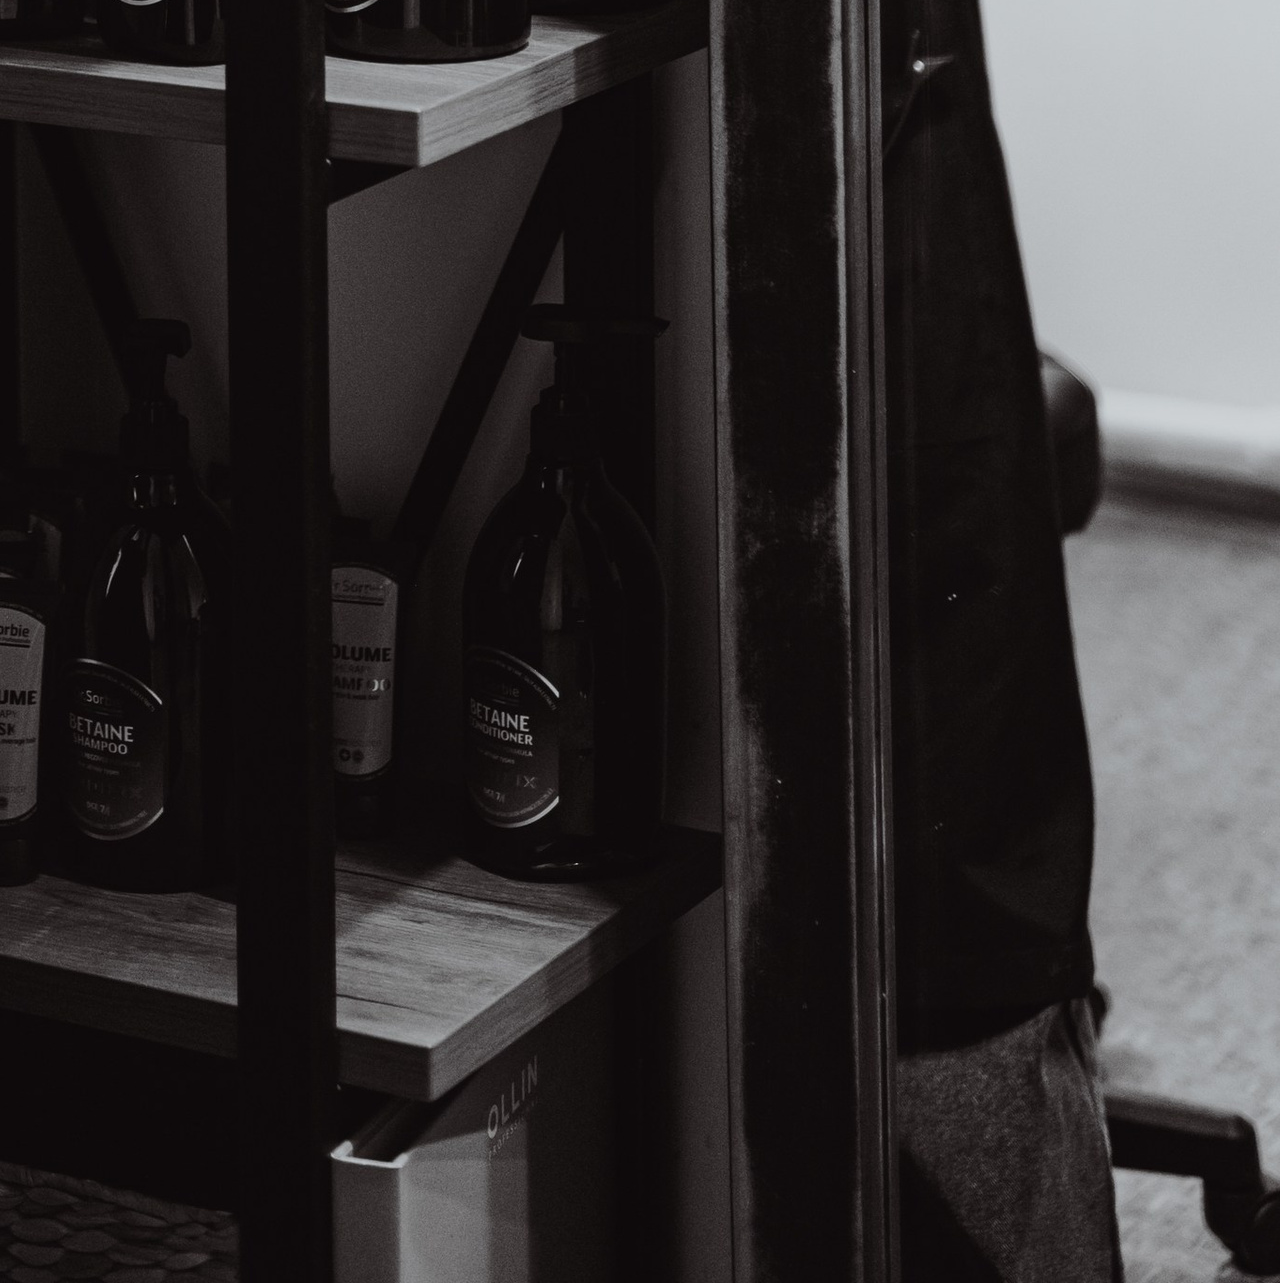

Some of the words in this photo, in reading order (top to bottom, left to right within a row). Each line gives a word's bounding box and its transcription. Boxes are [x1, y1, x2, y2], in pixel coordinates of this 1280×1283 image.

[331, 643, 392, 663] OLUME
[332, 676, 391, 693] AMPOO
[68, 711, 135, 743] BETAINE
[468, 714, 535, 746] ONDITIONER
[469, 696, 531, 733] BETAINE
[72, 731, 129, 755] SHAMPOO
[487, 1053, 538, 1140] OLLIN
